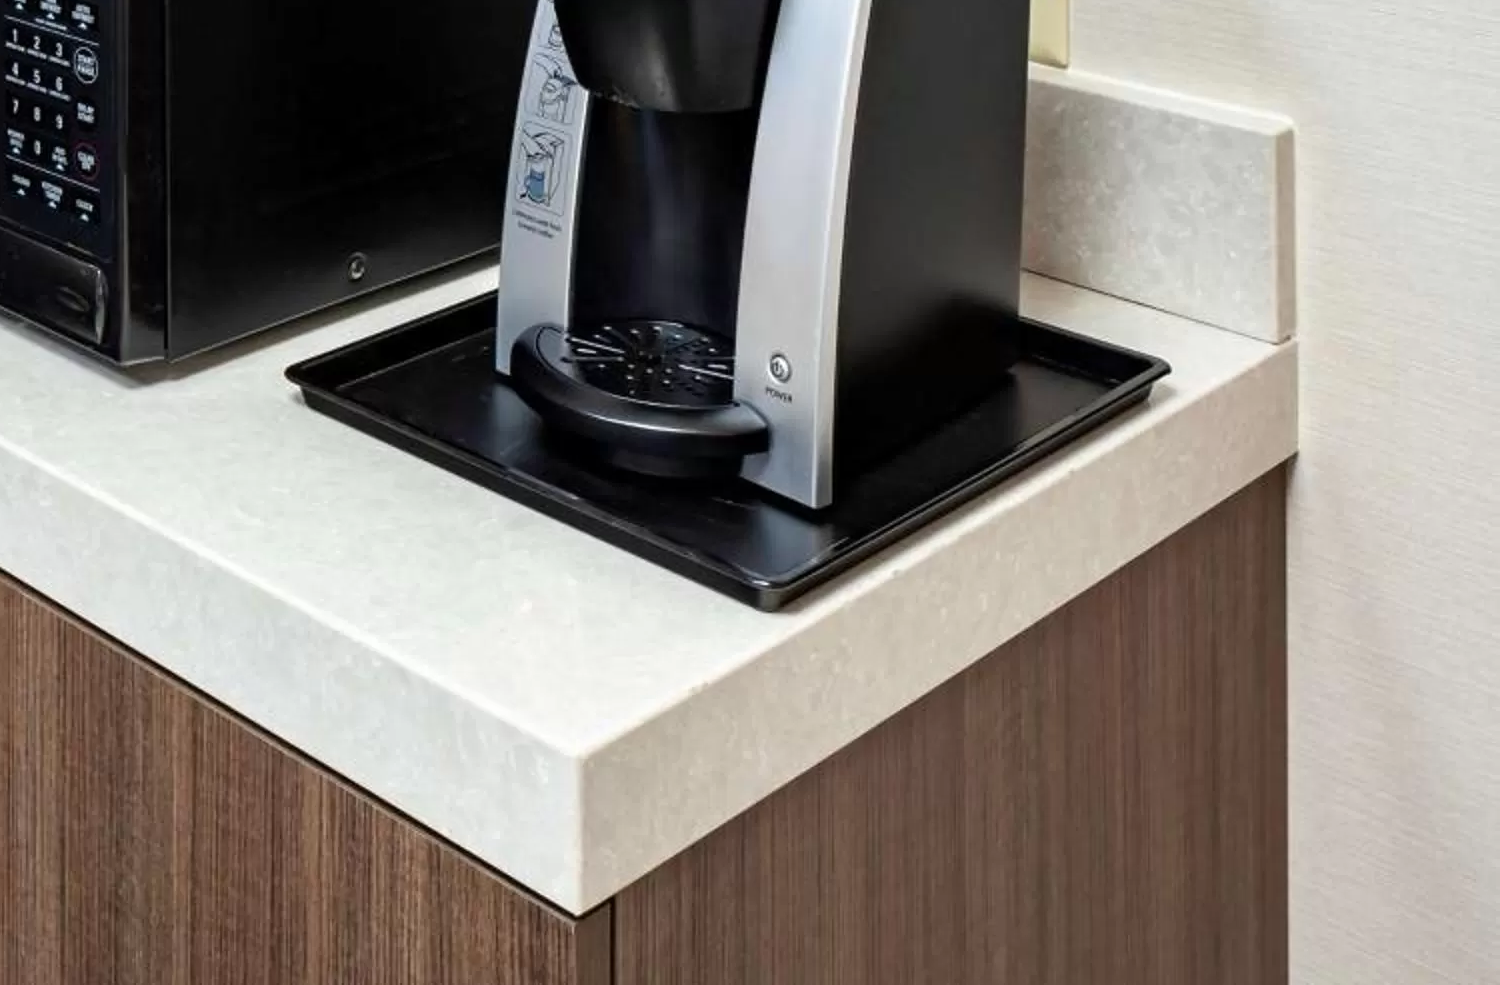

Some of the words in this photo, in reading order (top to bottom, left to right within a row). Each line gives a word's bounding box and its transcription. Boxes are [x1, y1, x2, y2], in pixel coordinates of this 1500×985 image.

[12, 28, 18, 43] 1
[33, 36, 41, 50] 2
[55, 43, 64, 57] 3
[11, 62, 19, 76] 4
[33, 69, 41, 84] 5
[55, 76, 63, 92] 6
[12, 99, 19, 114] 7
[33, 106, 41, 122] 8
[55, 114, 63, 130] 9
[33, 140, 41, 156] 0
